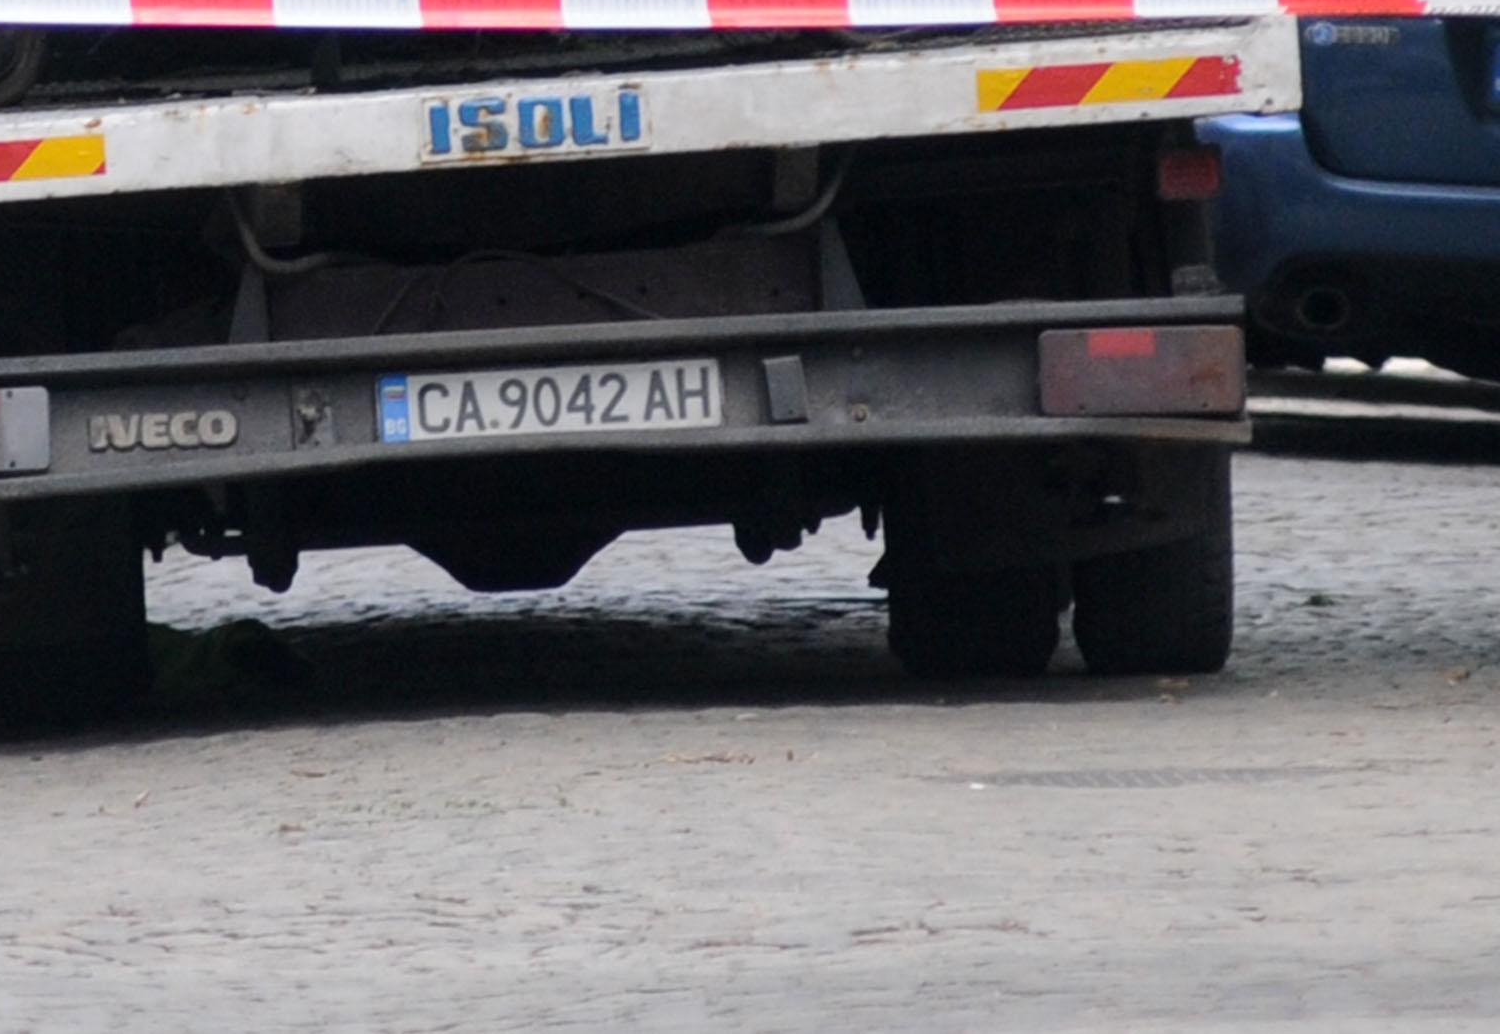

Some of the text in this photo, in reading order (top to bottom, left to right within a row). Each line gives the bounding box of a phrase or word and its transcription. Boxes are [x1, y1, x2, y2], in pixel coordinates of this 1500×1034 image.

[429, 91, 641, 154] ISOLI
[88, 410, 238, 451] IVECO
[384, 417, 408, 437] BG
